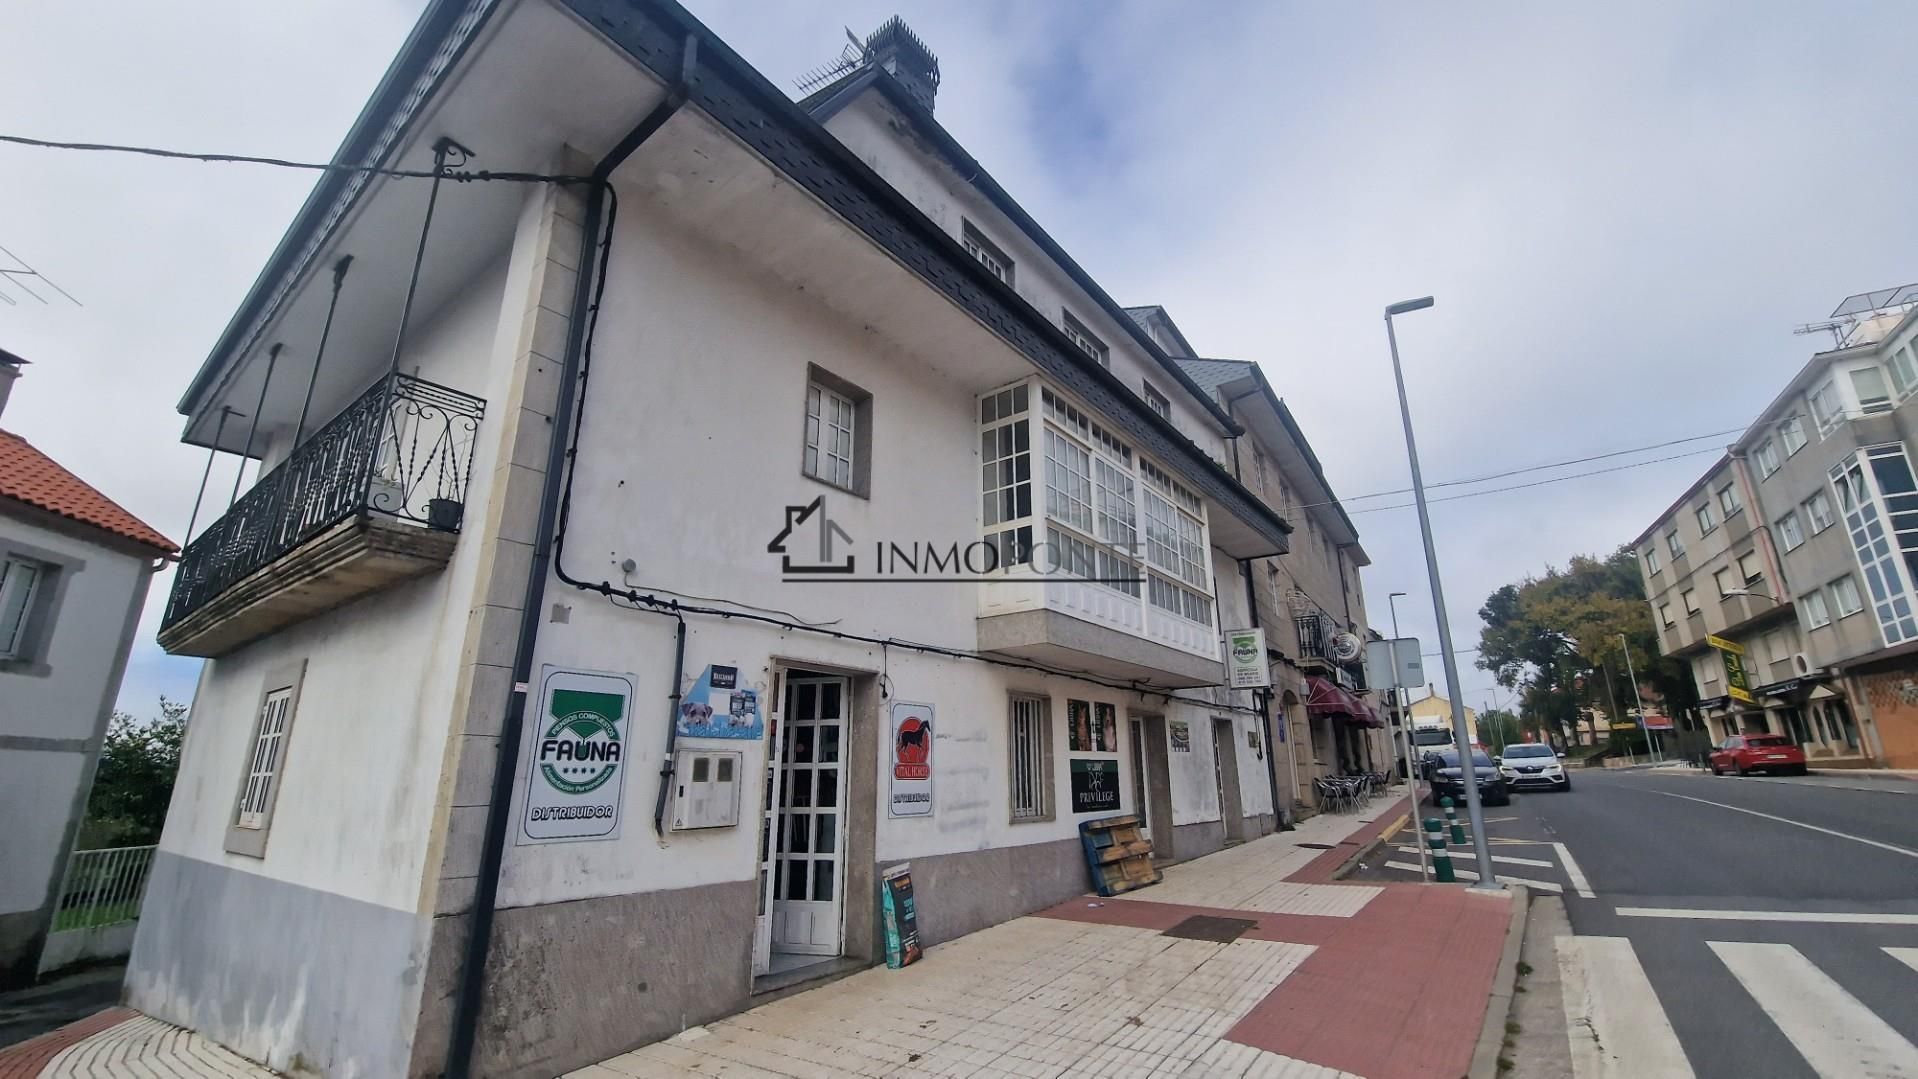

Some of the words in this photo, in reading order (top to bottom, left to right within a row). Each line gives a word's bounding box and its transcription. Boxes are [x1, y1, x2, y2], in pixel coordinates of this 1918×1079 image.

[552, 714, 578, 735] PIENSOS
[578, 712, 616, 737] COMPUESTOS
[540, 739, 621, 762] FAUNA
[1079, 791, 1114, 803] PRIVILEGE
[531, 806, 614, 821] DISTRIBUIDOR
